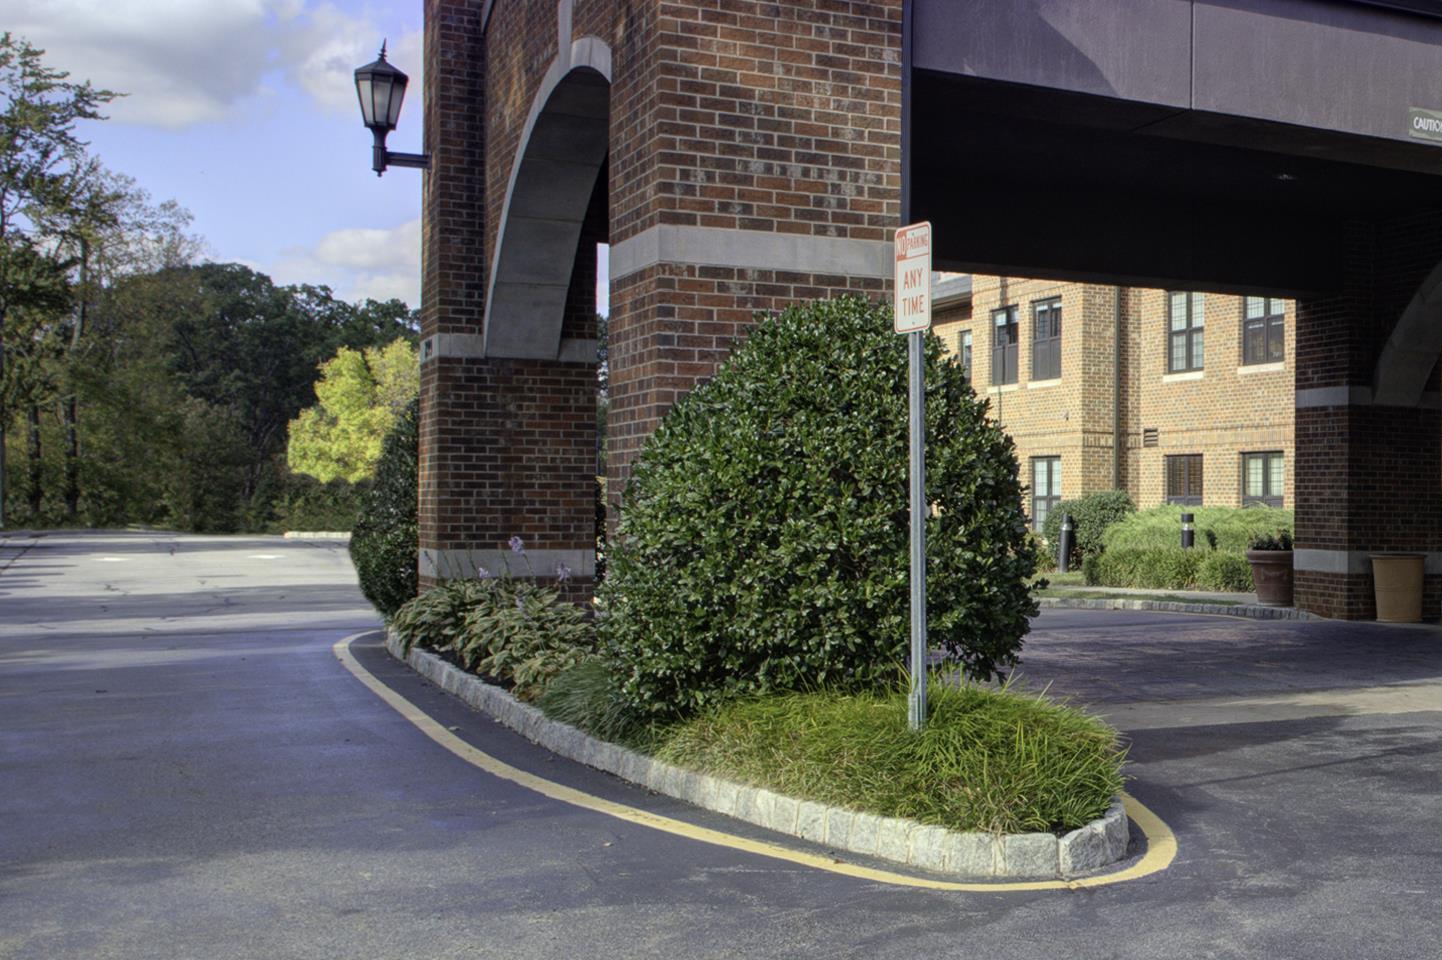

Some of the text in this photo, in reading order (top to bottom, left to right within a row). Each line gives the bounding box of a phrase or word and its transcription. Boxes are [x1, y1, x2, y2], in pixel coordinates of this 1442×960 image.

[896, 235, 907, 257] NO
[903, 267, 923, 290] ANY
[902, 294, 925, 317] TIME
